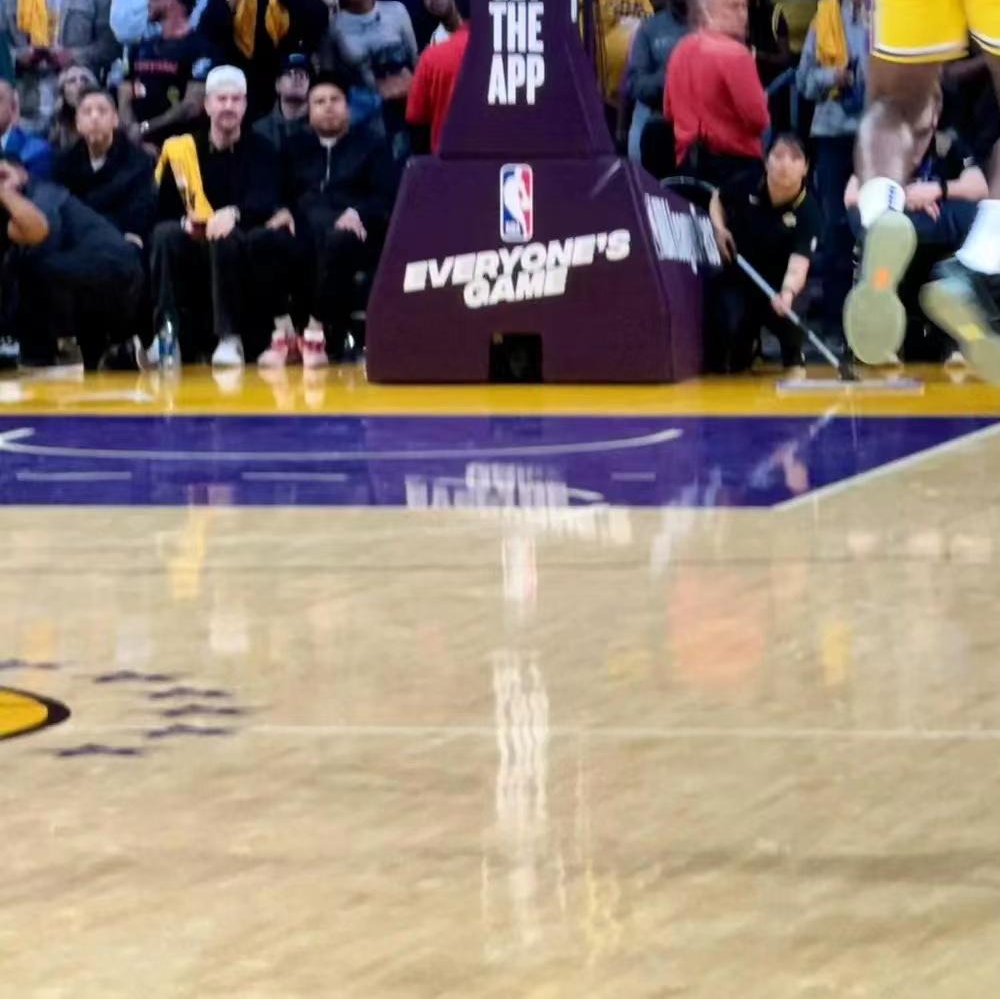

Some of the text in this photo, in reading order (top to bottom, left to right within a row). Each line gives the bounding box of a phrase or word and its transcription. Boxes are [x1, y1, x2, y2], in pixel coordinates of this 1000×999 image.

[488, 2, 545, 54] THE
[487, 54, 546, 106] APP
[403, 228, 632, 293] EVERYONE'S
[462, 267, 569, 309] GAME
